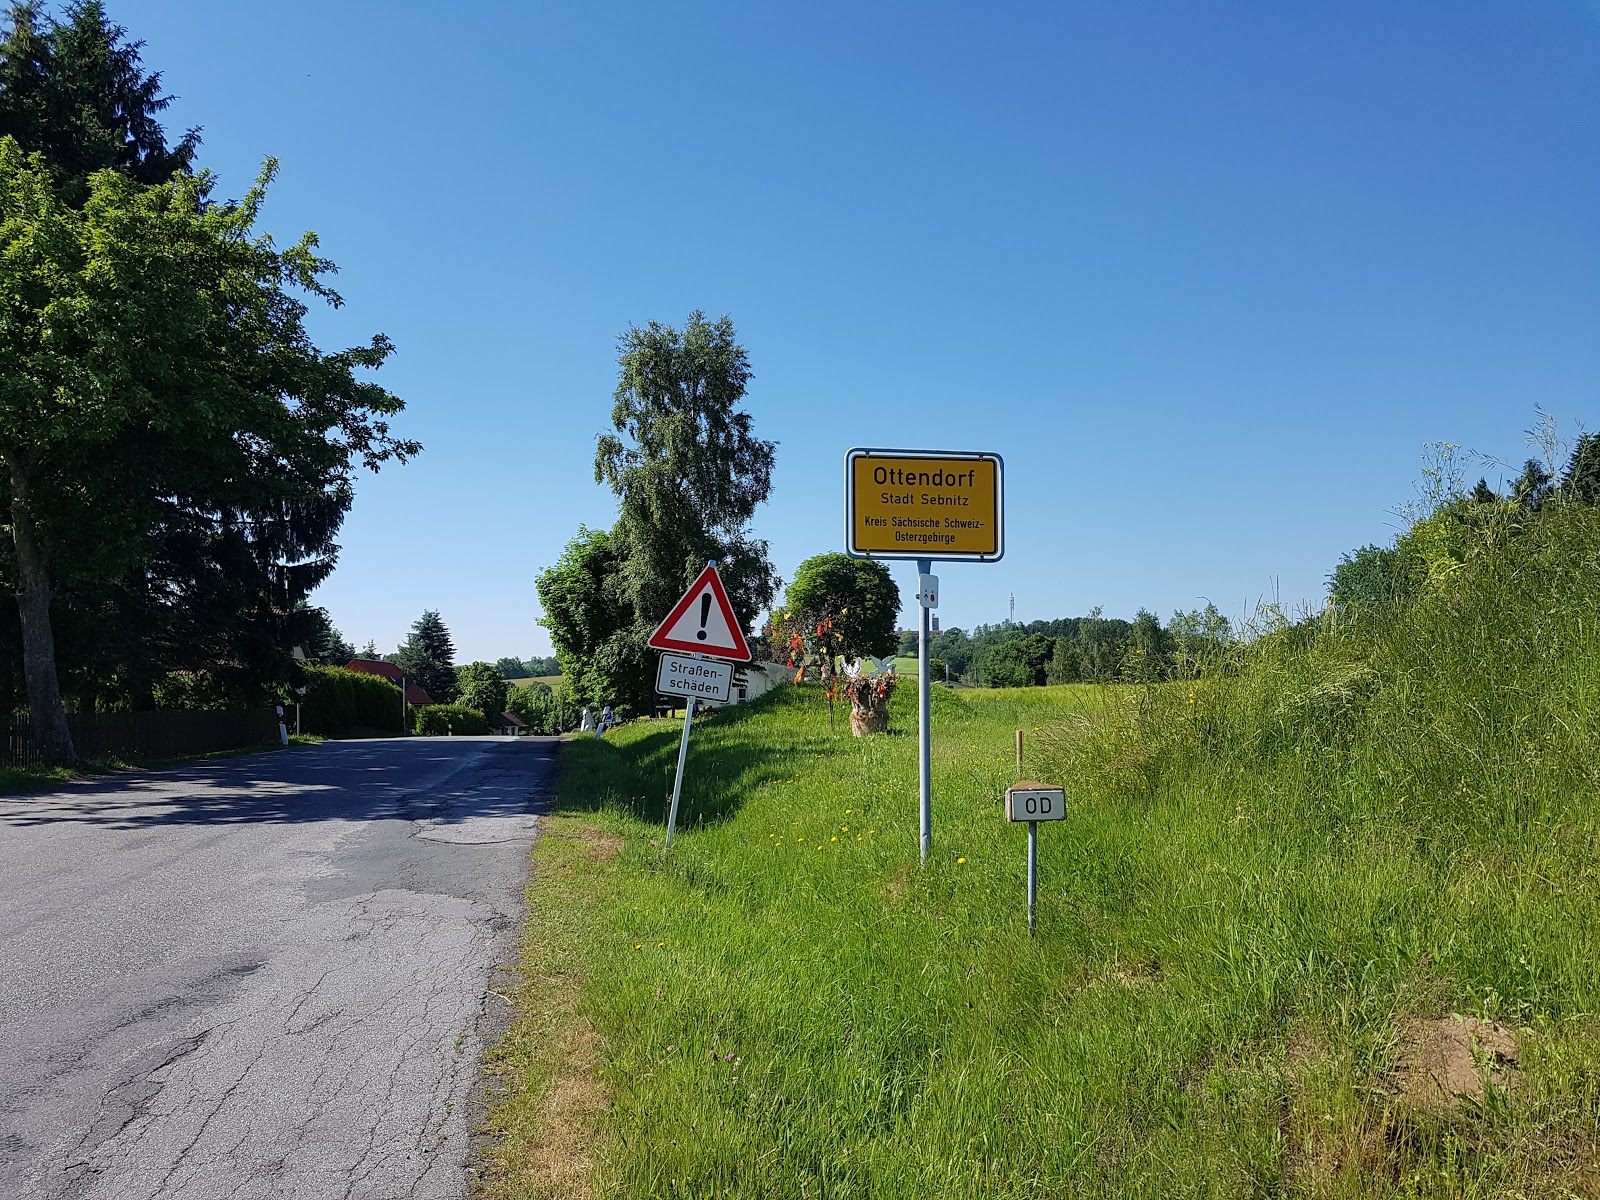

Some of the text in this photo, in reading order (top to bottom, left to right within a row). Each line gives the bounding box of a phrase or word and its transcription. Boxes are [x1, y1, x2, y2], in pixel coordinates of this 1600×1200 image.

[873, 466, 975, 488] Ottendorf
[881, 492, 969, 506] Stadt Sebnitz
[864, 515, 985, 529] Kreis Sächsische Schweiz-
[895, 531, 956, 545] Osterzgebirge
[669, 661, 723, 679] Straßen-
[669, 678, 719, 694] schäden
[1025, 797, 1052, 814] OD
